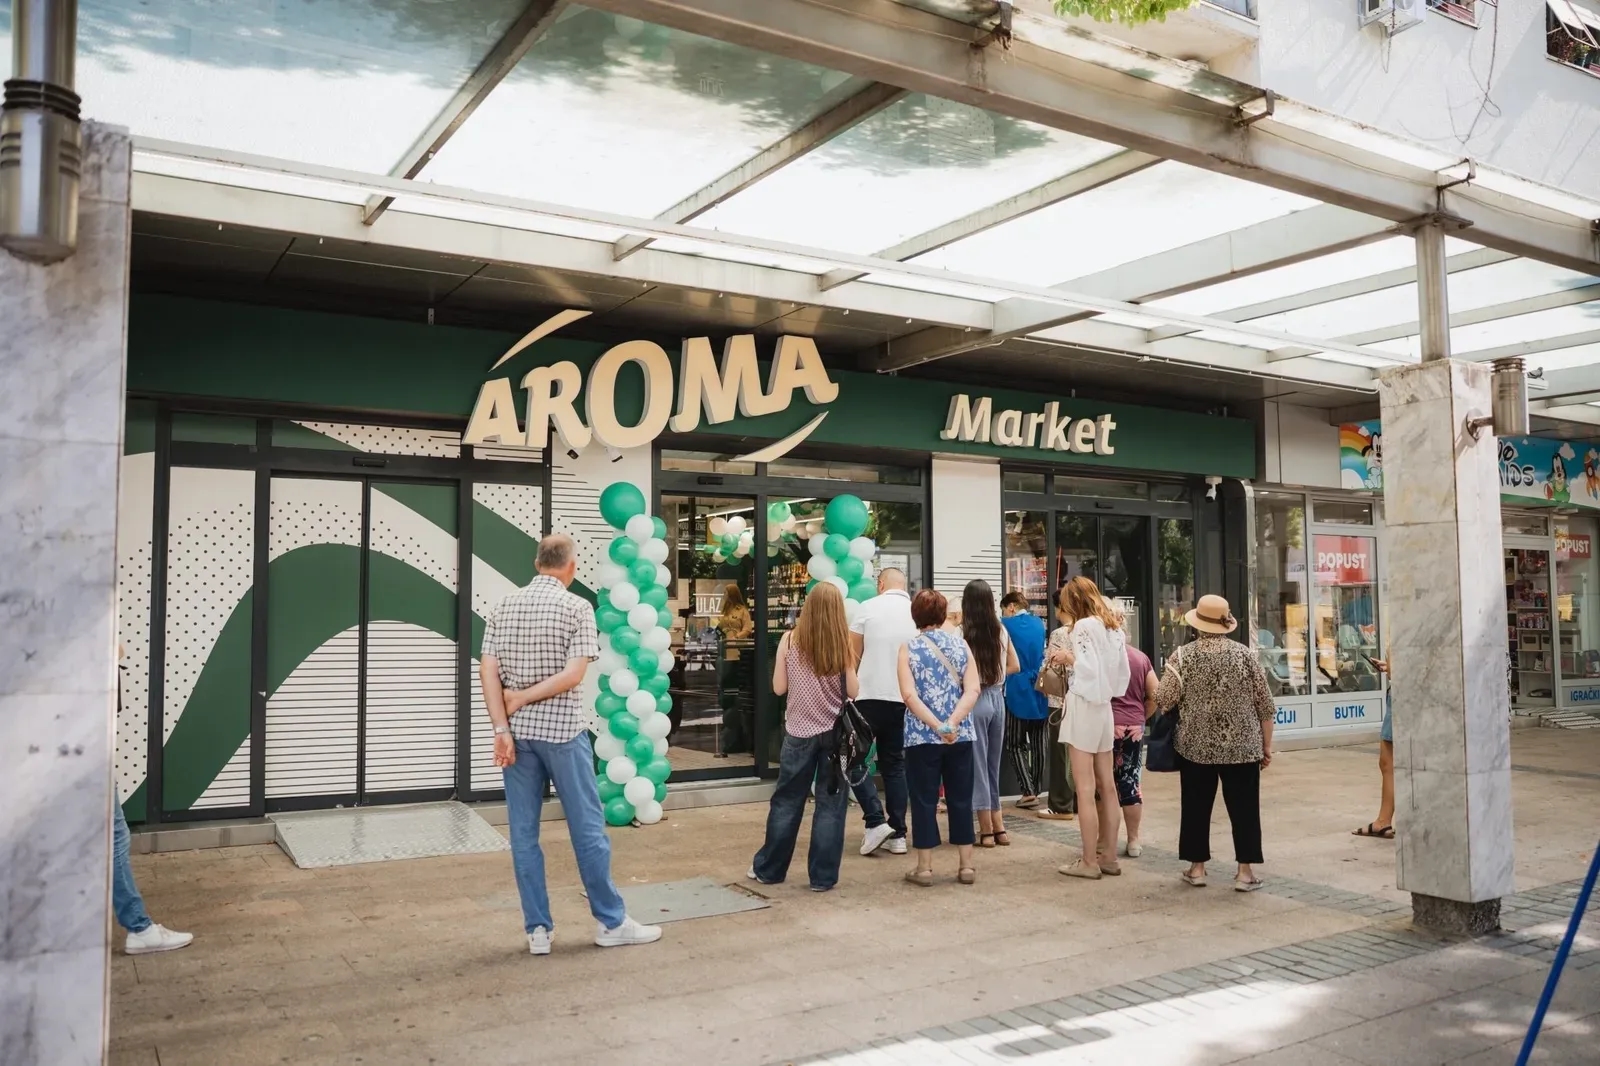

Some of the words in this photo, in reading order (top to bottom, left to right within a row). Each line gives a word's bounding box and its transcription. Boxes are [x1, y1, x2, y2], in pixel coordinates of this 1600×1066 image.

[462, 333, 839, 449] AROMA
[940, 393, 1117, 455] Market
[1554, 538, 1590, 554] POPUST
[1318, 552, 1367, 569] POPUST
[695, 597, 722, 613] ULAZ
[1334, 705, 1365, 720] BUTIK
